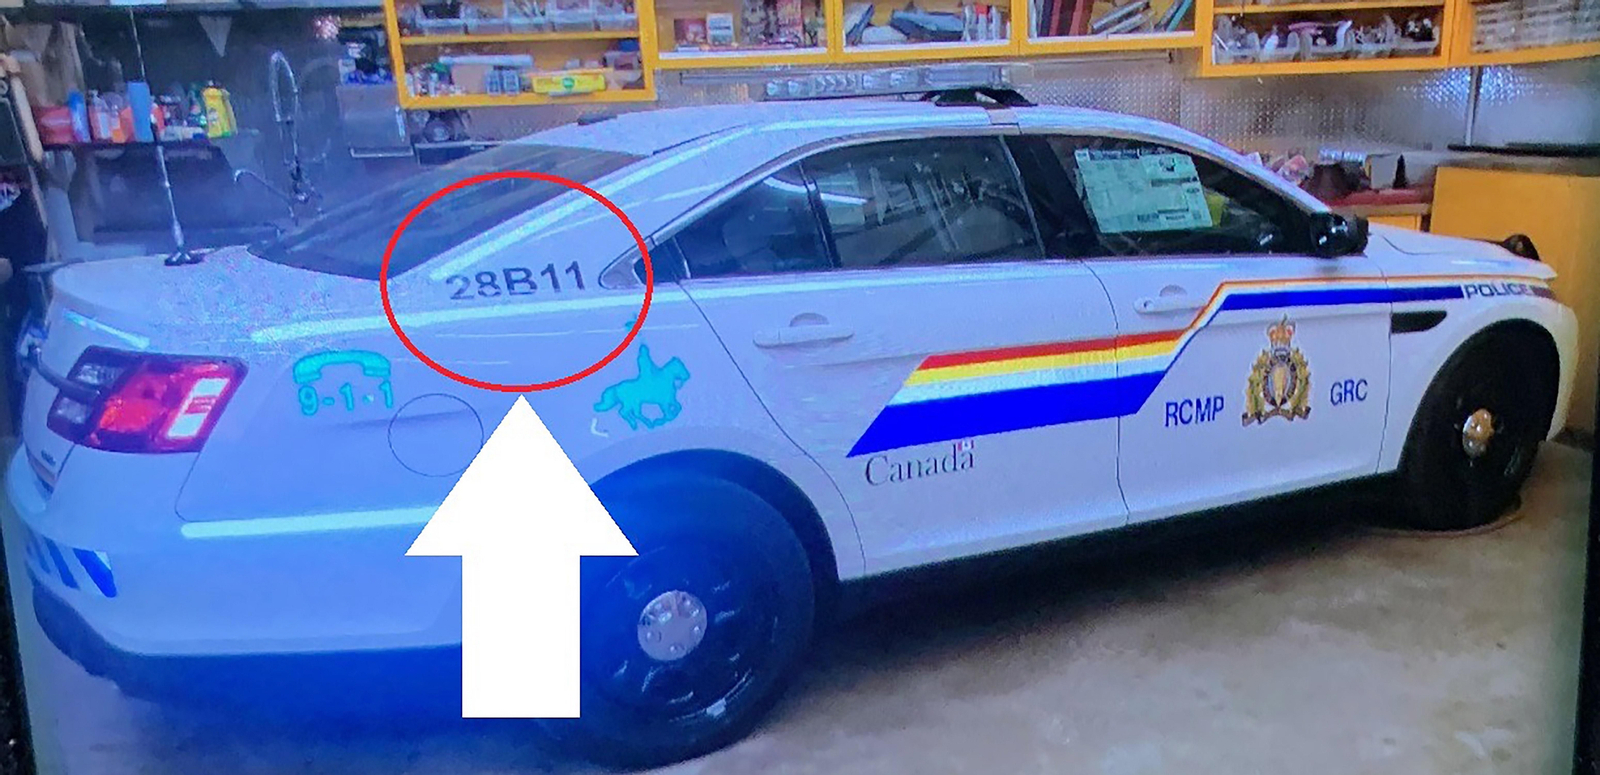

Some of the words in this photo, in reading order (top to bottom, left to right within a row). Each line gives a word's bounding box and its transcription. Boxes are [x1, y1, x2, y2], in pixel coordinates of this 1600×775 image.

[445, 261, 585, 300] 28B11
[1464, 282, 1533, 299] POLICE
[298, 381, 393, 416] 9-1-1
[1330, 379, 1368, 406] GRC
[1165, 396, 1225, 427] RCMP
[865, 443, 975, 486] Canada
